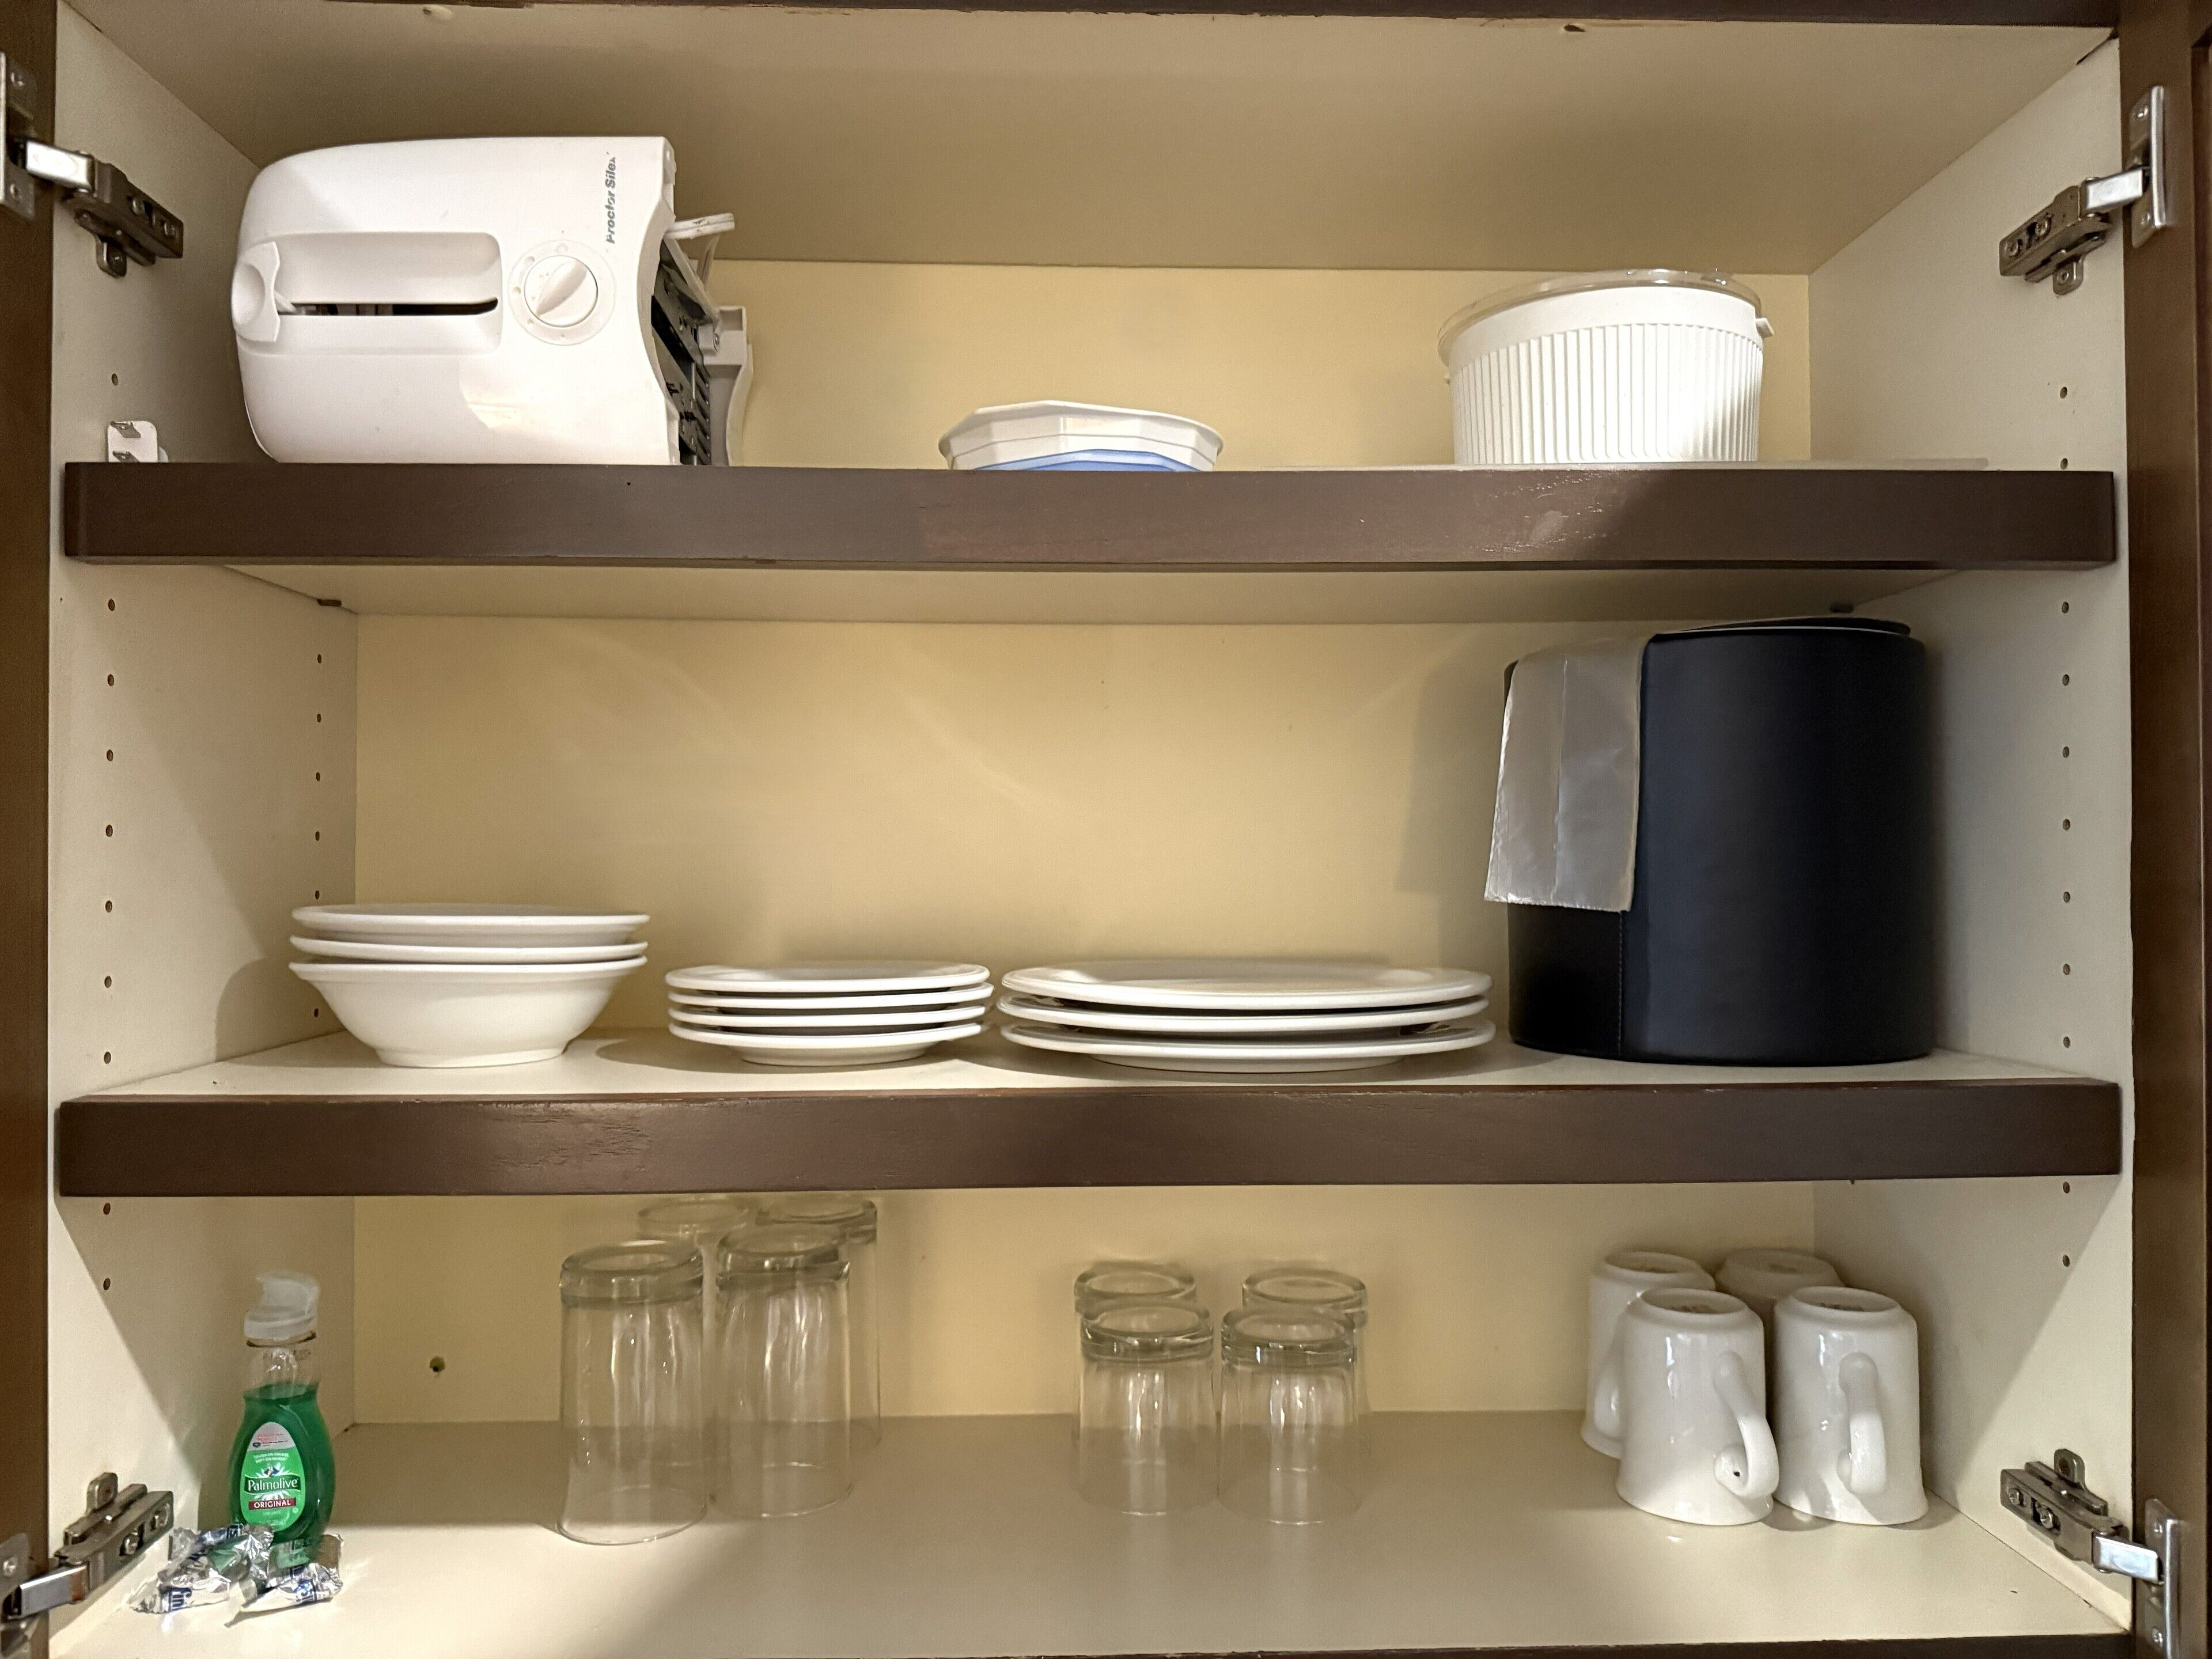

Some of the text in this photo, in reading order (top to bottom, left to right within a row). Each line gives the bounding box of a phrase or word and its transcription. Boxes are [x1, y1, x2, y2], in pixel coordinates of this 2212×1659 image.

[604, 191, 616, 244] Proctor
[248, 1478, 298, 1492] Palmolive
[253, 1499, 291, 1508] ORIGINAL
